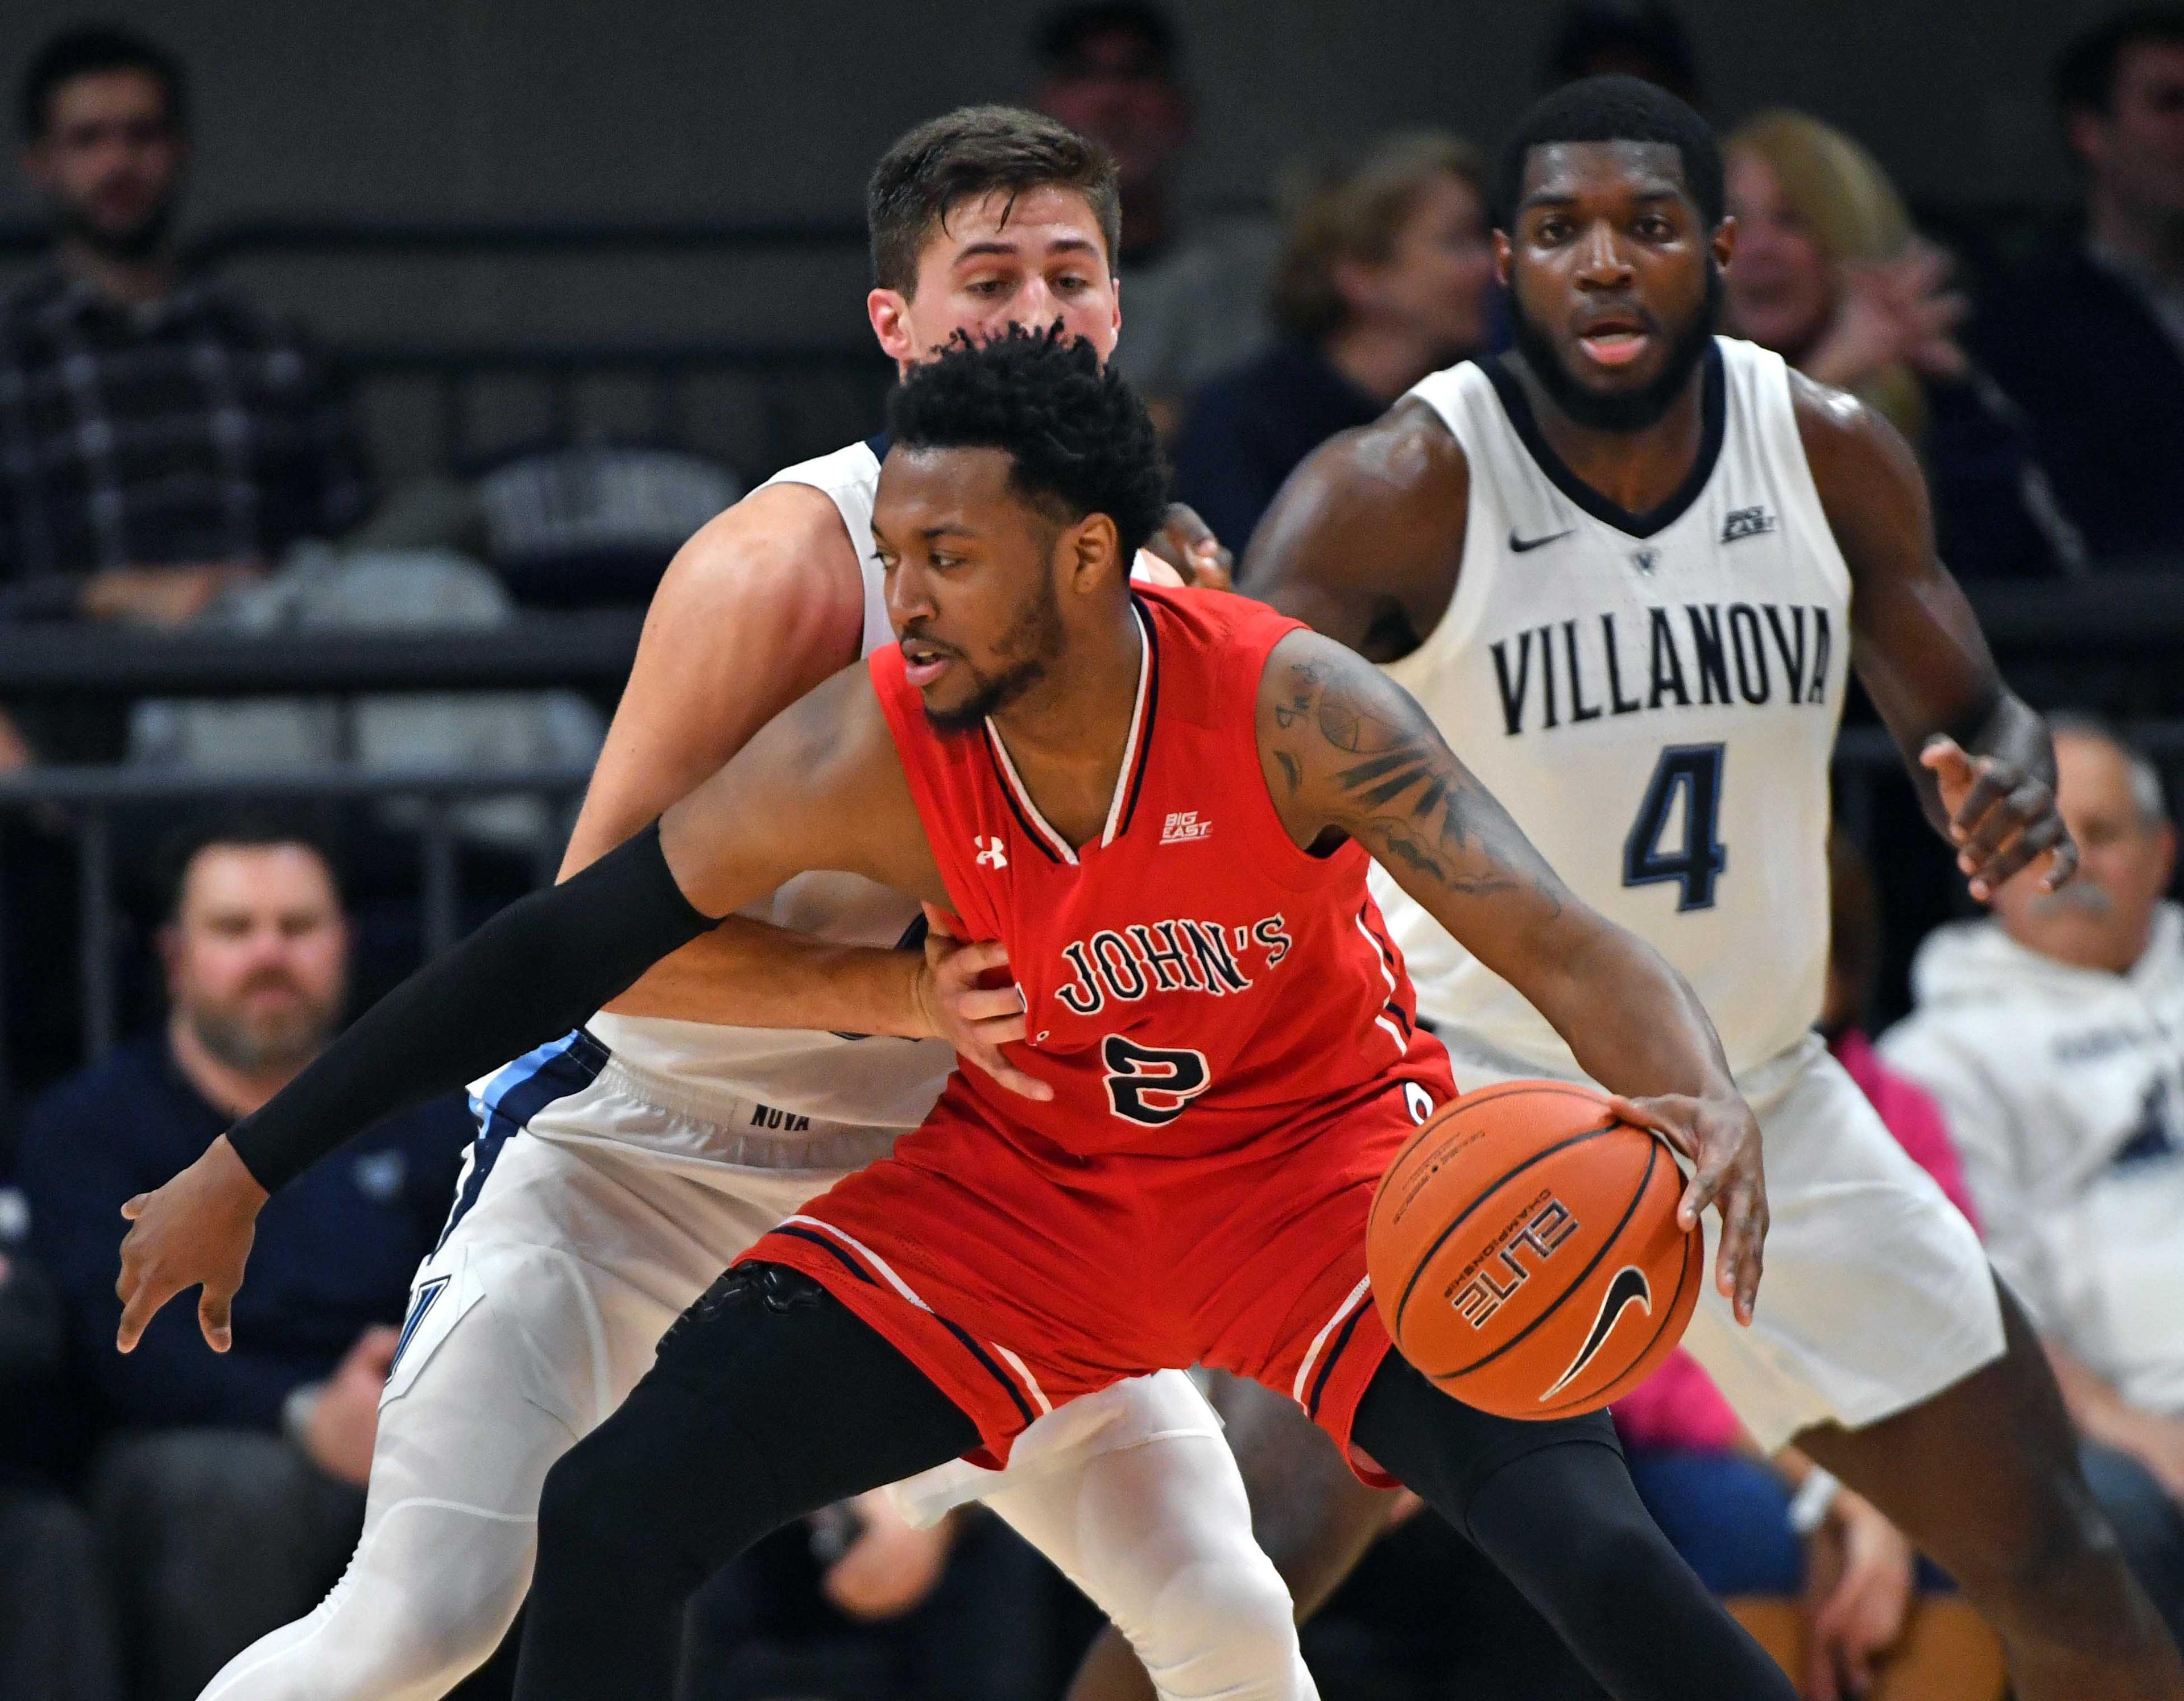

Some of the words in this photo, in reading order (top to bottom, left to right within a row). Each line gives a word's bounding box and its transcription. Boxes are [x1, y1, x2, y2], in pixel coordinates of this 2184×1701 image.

[1488, 602, 1833, 736] VILLANOVA
[1161, 820, 1212, 839] EAST
[1164, 810, 1198, 826] BIG
[1622, 741, 1727, 913] 4
[1054, 912, 1292, 1015] JOHN'S
[1101, 1033, 1211, 1128] 2
[1443, 1188, 1552, 1298] CHAMPIONSHIP
[1451, 1197, 1579, 1331] ELITE
